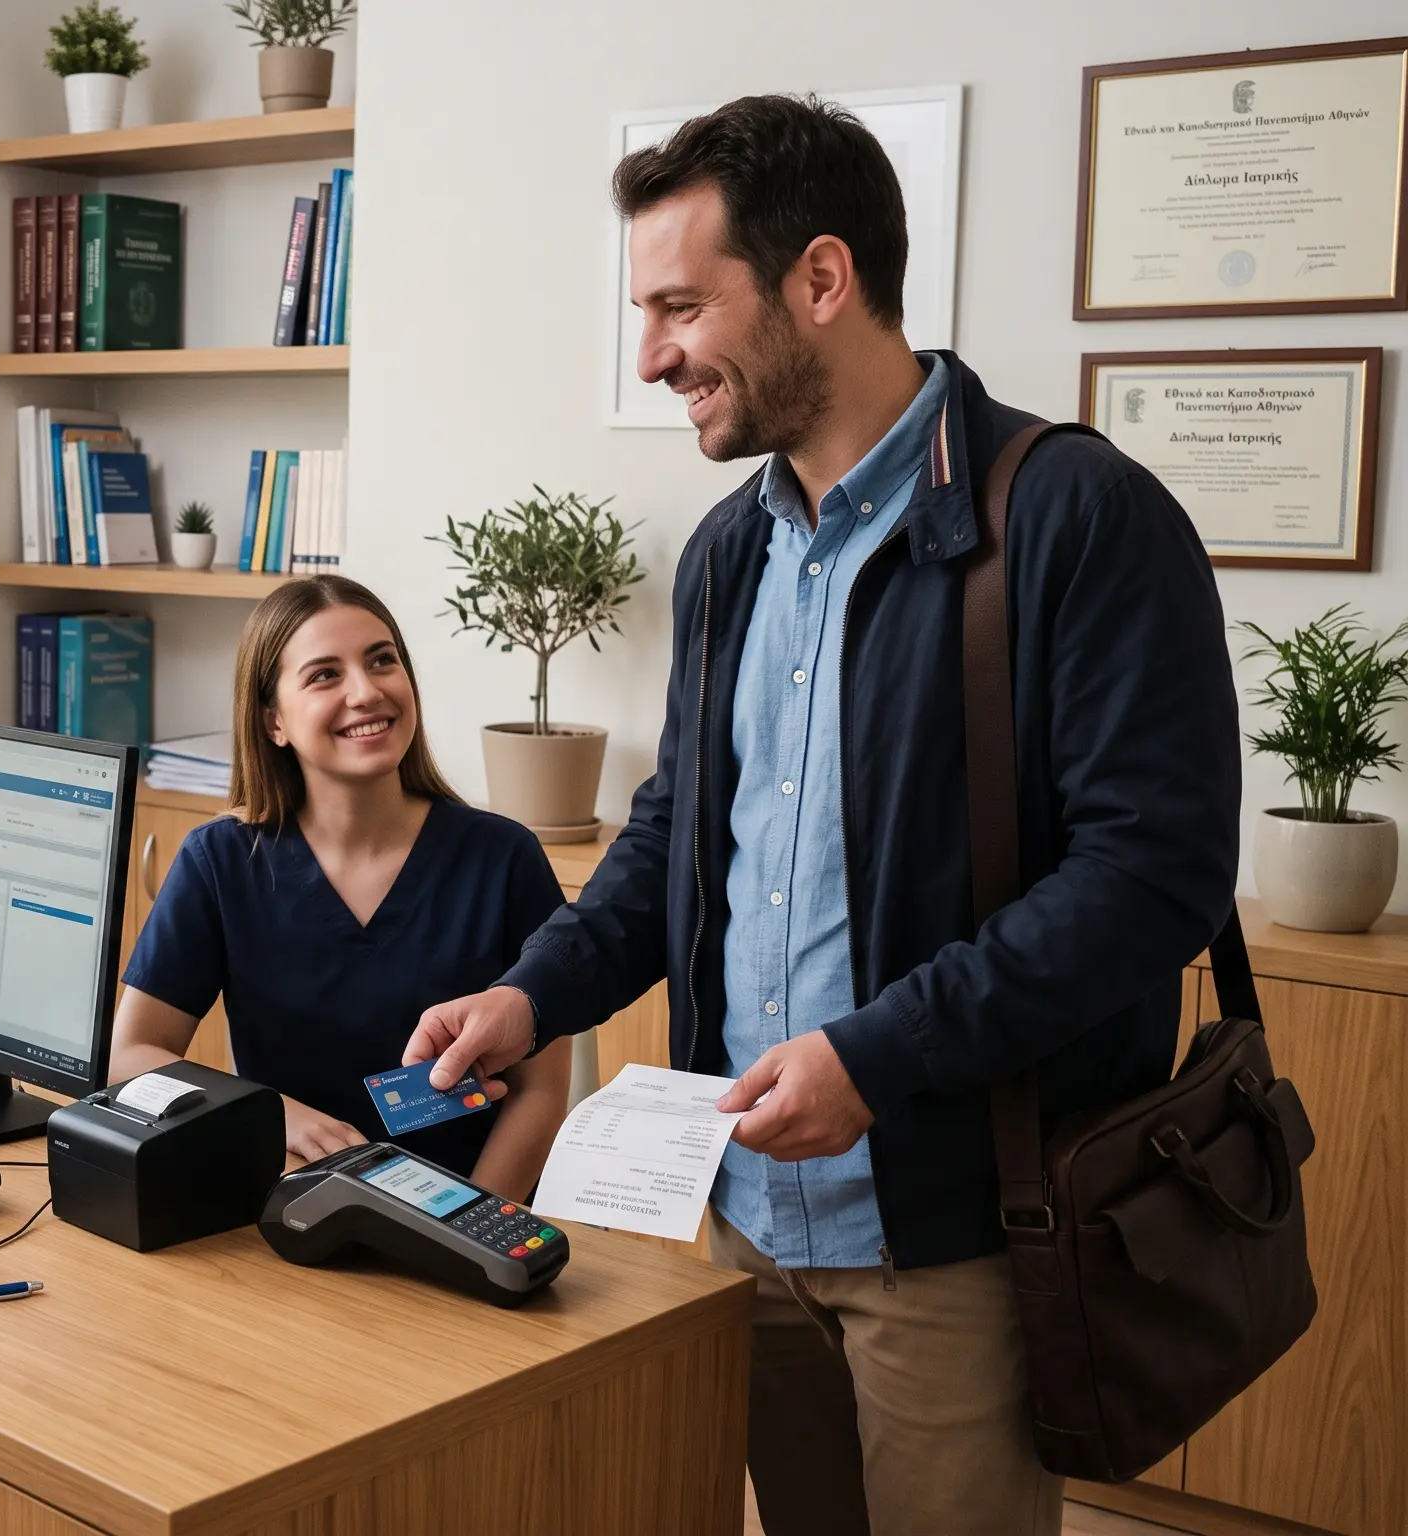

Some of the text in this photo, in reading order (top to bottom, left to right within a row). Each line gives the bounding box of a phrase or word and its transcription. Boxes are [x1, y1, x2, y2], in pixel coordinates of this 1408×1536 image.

[1244, 169, 1299, 186] Ιατρικής
[1164, 387, 1315, 401] Εθνικό και Καποδιστριακό
[1256, 401, 1302, 413] Αθηνών
[1169, 432, 1282, 446] Δίπλωμα Ιατρικής
